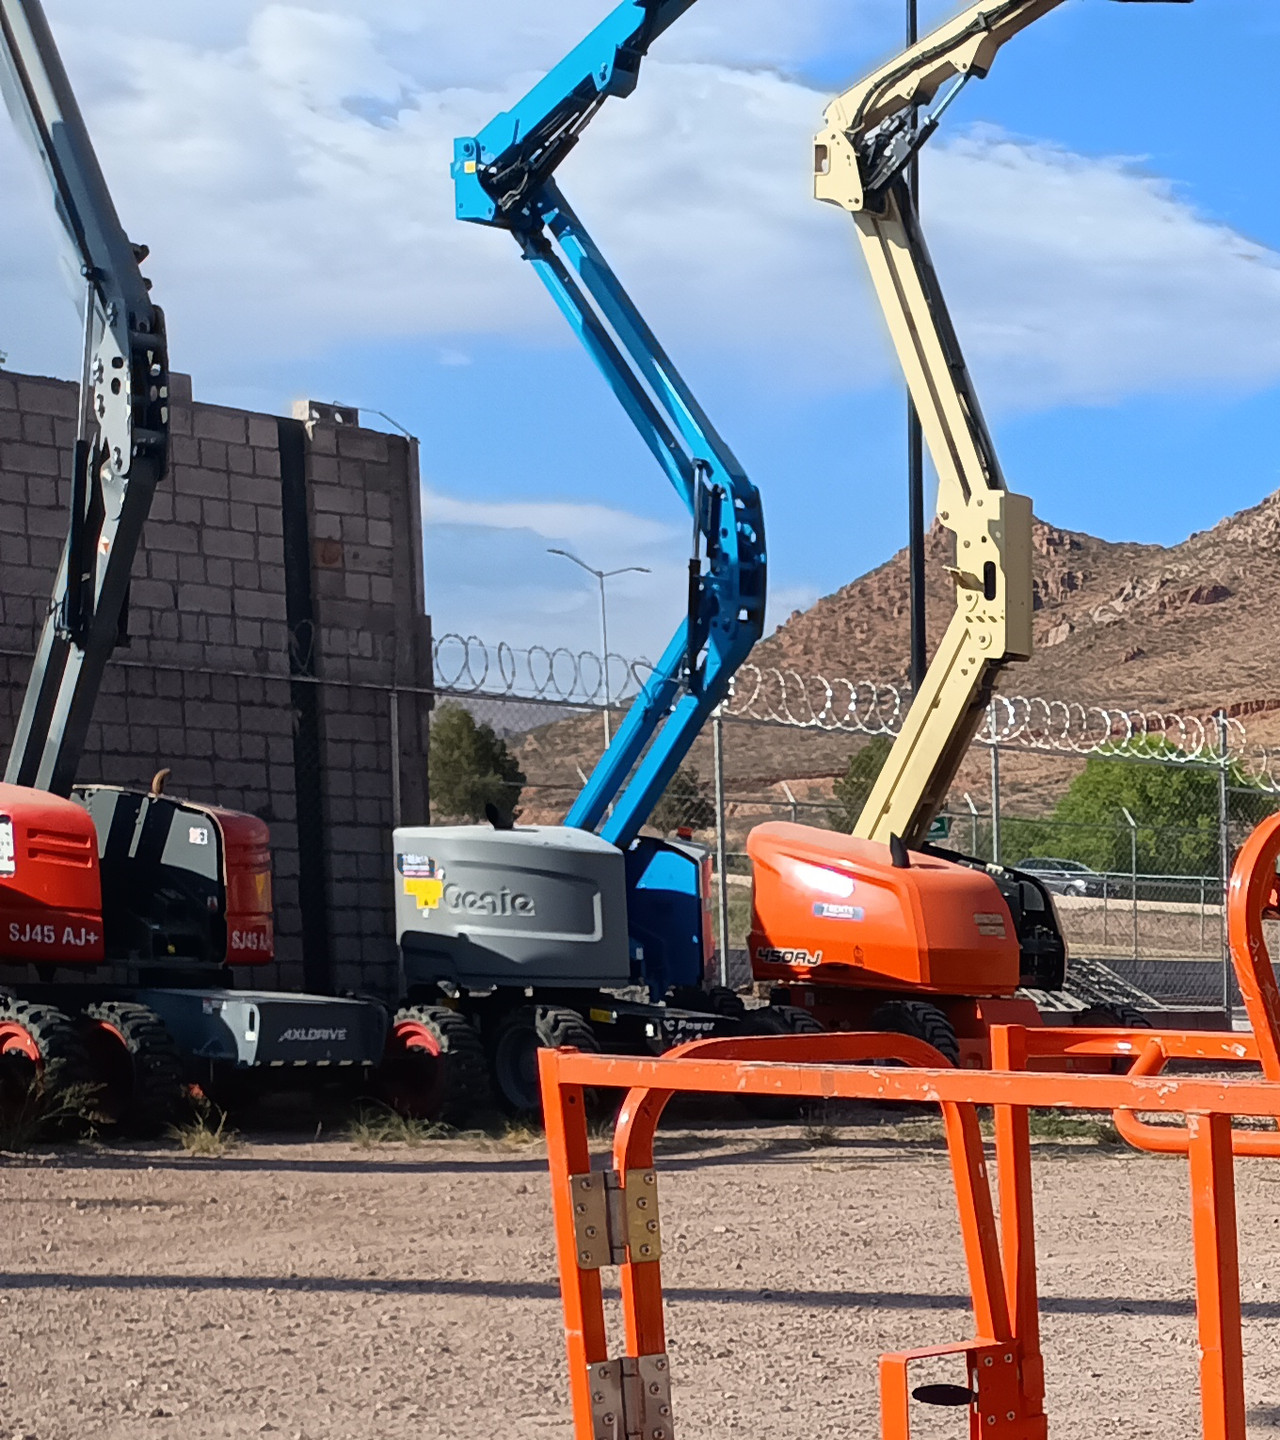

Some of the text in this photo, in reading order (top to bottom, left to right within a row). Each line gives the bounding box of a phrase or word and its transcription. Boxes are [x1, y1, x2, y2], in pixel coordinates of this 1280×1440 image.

[443, 883, 536, 916] Genie
[9, 922, 99, 946] SJ45 AJ+
[757, 946, 822, 967] 450AJ
[678, 1020, 715, 1031] Power
